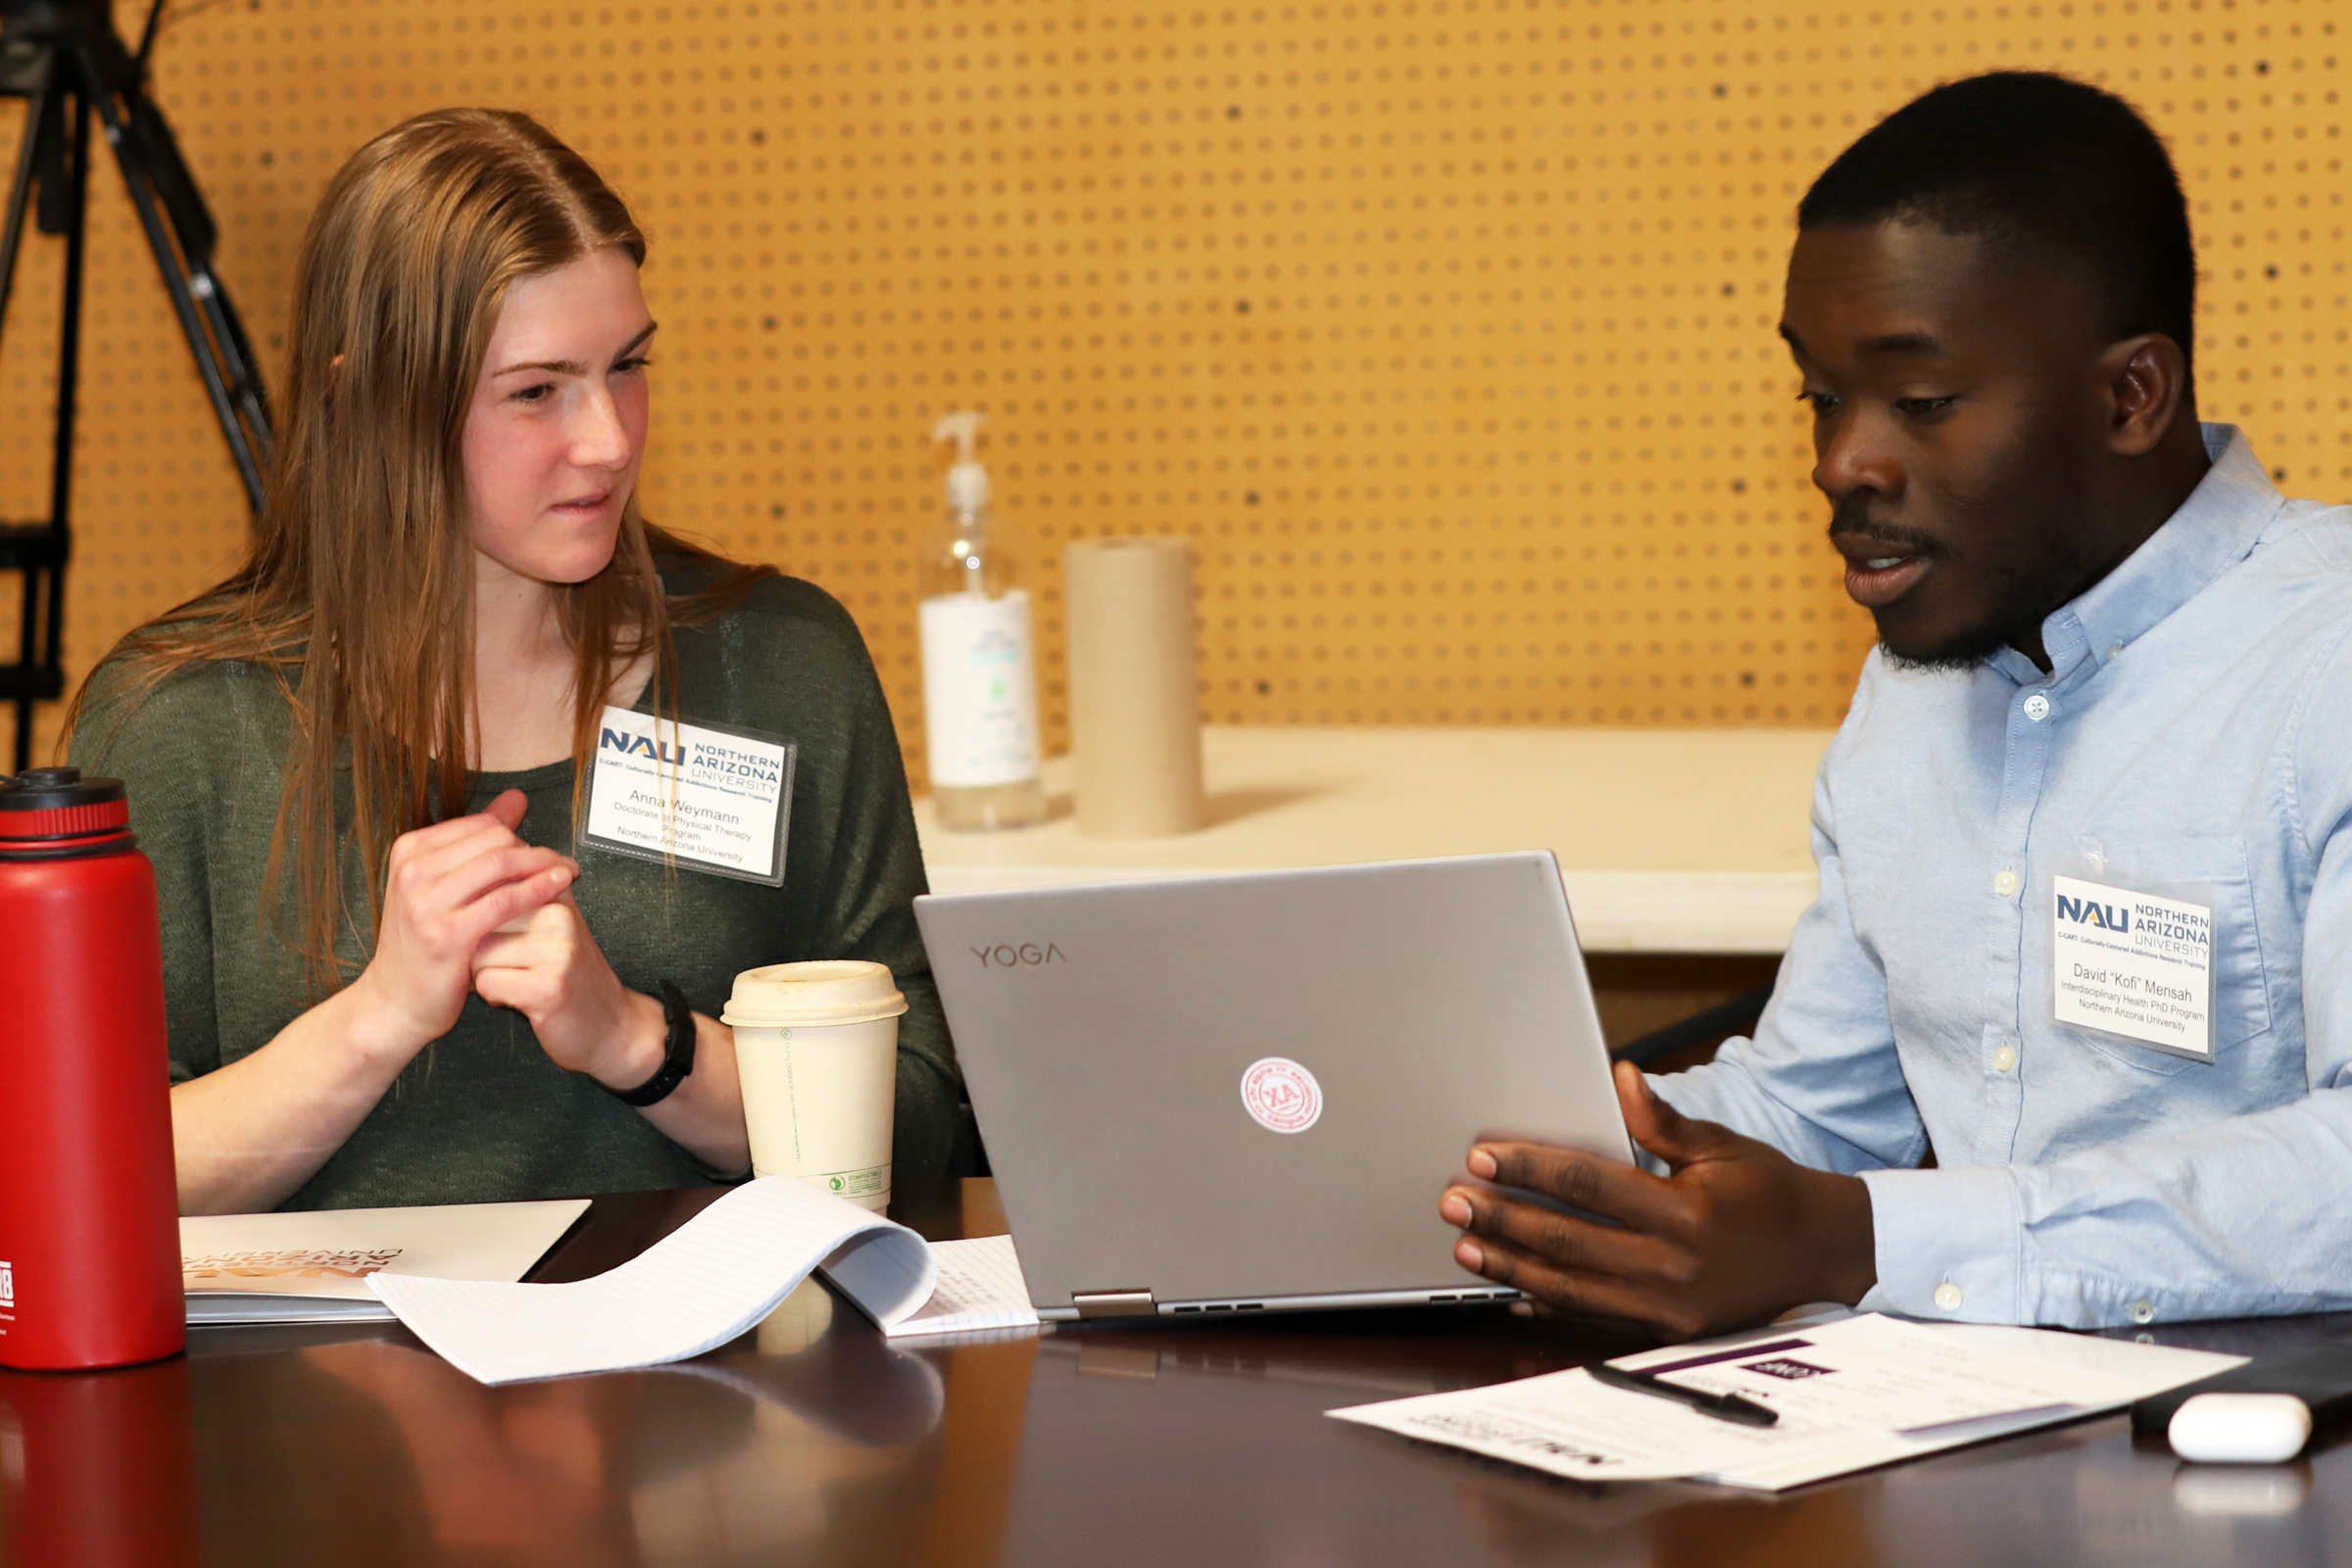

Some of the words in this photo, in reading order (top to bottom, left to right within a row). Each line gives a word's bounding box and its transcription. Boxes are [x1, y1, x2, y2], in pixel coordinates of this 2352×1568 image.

[601, 727, 686, 766] NAU
[695, 743, 780, 769] NORTHERN
[692, 767, 777, 794] UNIVERSITY
[693, 755, 778, 783] ARIZONA
[629, 789, 665, 808] Anna
[670, 798, 739, 824] Weymann
[718, 786, 746, 797] Research
[748, 792, 772, 804] Training
[613, 801, 659, 819] Doctorate
[673, 814, 711, 831] Physical
[714, 824, 752, 842] Therapy
[662, 824, 702, 841] Program
[617, 825, 658, 843] Northern
[660, 836, 695, 852] Arizona
[698, 844, 743, 863] University
[2056, 894, 2129, 934] NAU
[2135, 903, 2209, 929] NORTHERN
[2134, 917, 2209, 946] ARIZONA
[970, 942, 1067, 968] YOGA
[2131, 948, 2158, 959] Addictions
[2159, 954, 2183, 965] Research
[2184, 958, 2206, 971] Training
[2134, 933, 2209, 959] UNIVERSITY
[2074, 962, 2106, 983] David
[2110, 971, 2141, 990] “Kofi”
[2145, 979, 2192, 1003] Mensah
[2061, 979, 2121, 1004] Interdisciplinary
[2123, 994, 2149, 1008] Health
[2151, 1000, 2169, 1012] PhD
[2171, 1004, 2205, 1021] Program
[2079, 998, 2113, 1014] Northern
[2114, 1006, 2144, 1021] Arizona
[2146, 1013, 2185, 1033] University
[1268, 1115, 1304, 1128] campus
